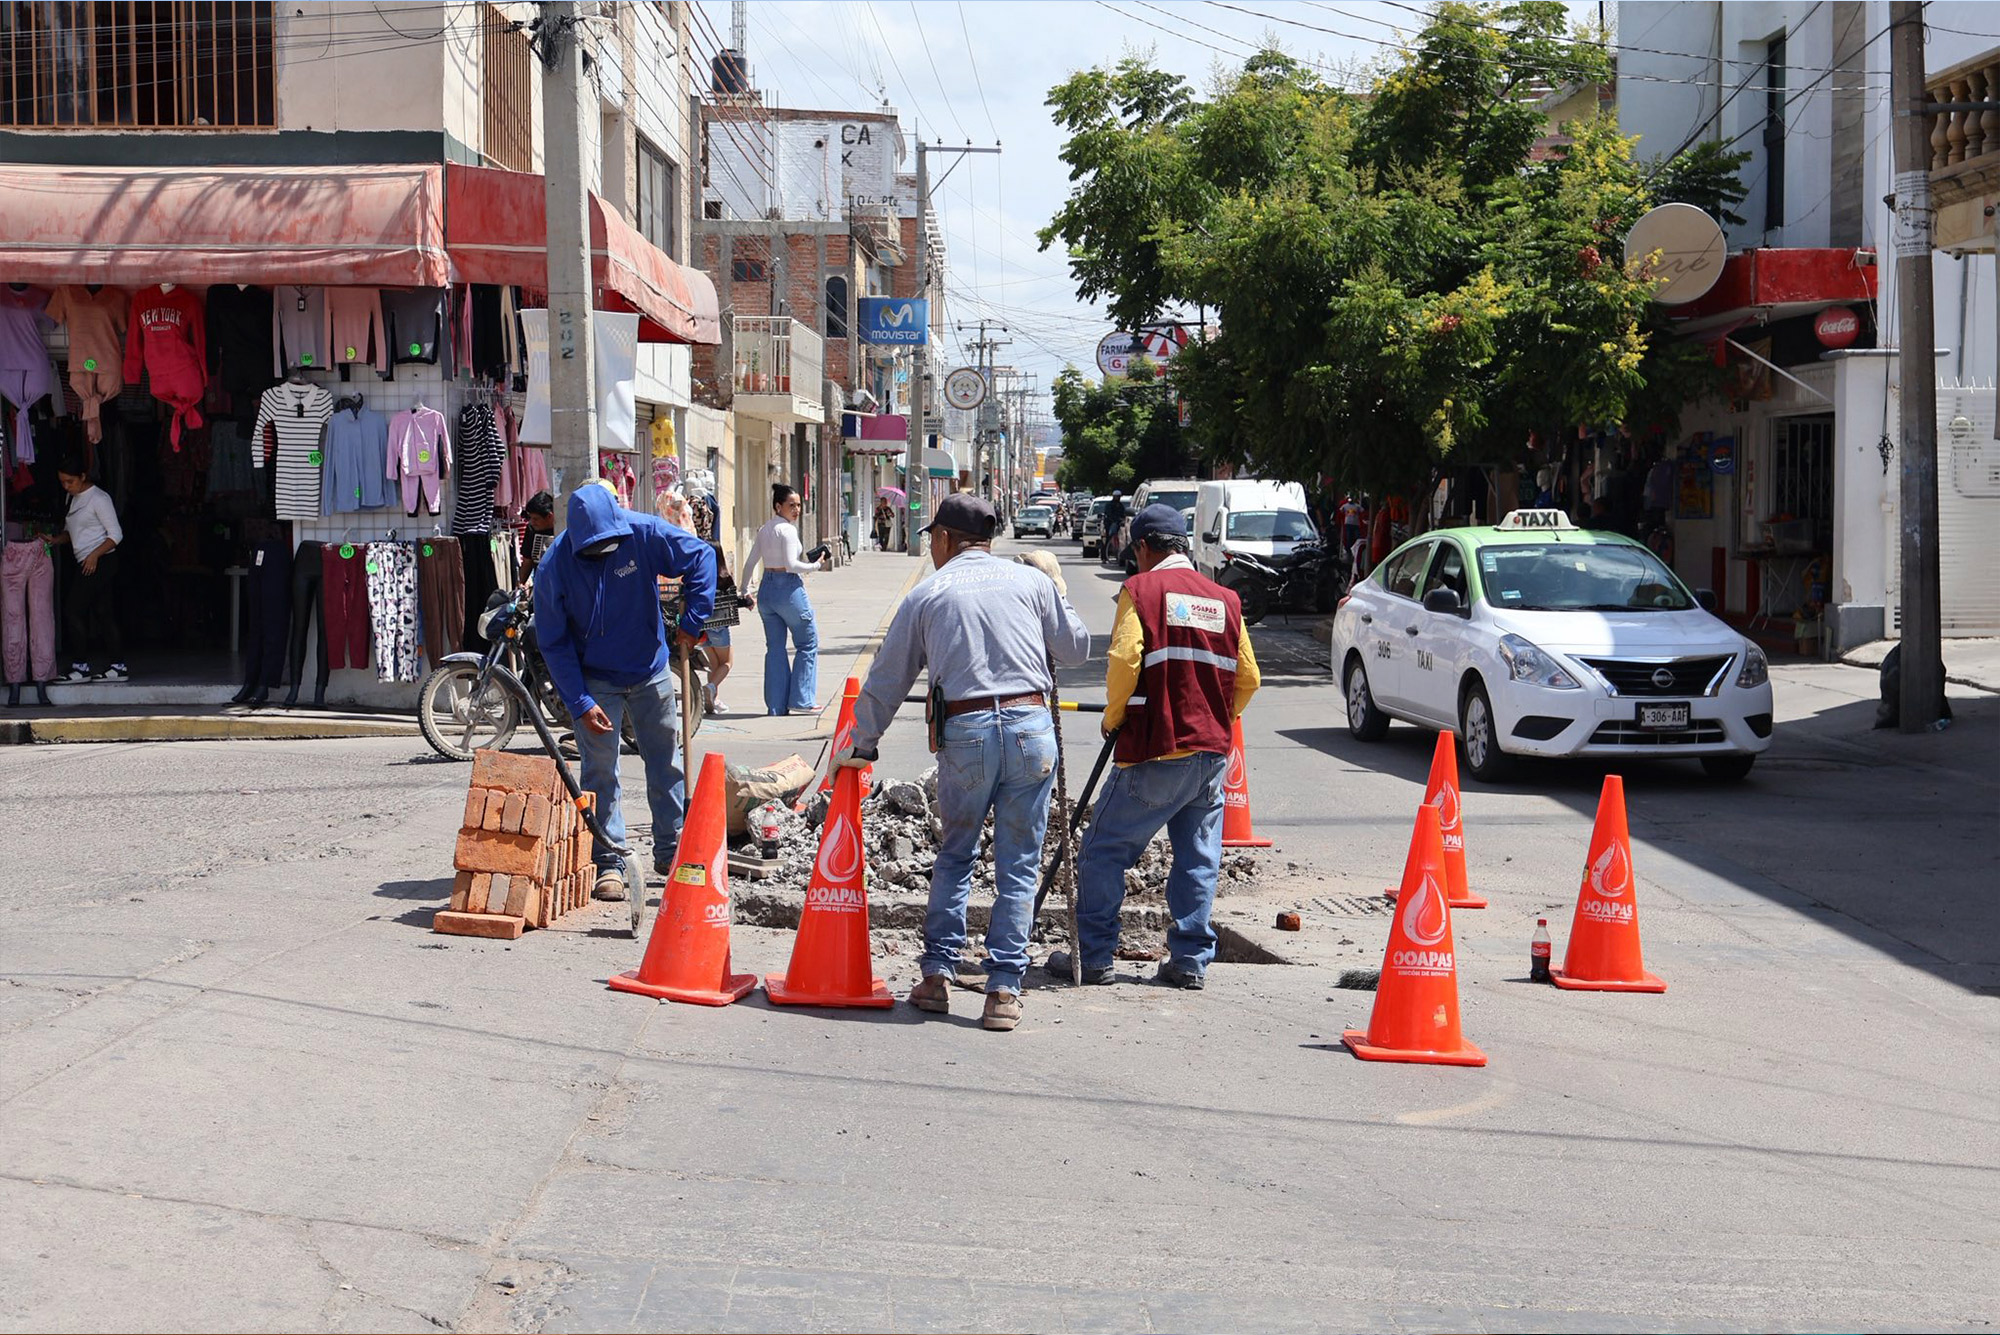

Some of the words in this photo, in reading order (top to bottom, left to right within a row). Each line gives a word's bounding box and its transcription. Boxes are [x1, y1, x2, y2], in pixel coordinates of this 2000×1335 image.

[161, 307, 182, 326] YORK
[871, 330, 921, 340] movistar
[1517, 511, 1559, 527] TAXI
[955, 565, 1014, 578] BLESSING
[955, 573, 1016, 586] HOSPITAL
[1377, 640, 1391, 659] 306
[1417, 649, 1433, 671] TAXI
[808, 887, 864, 904] OOAPAS
[1393, 950, 1453, 968] OOAPAS
